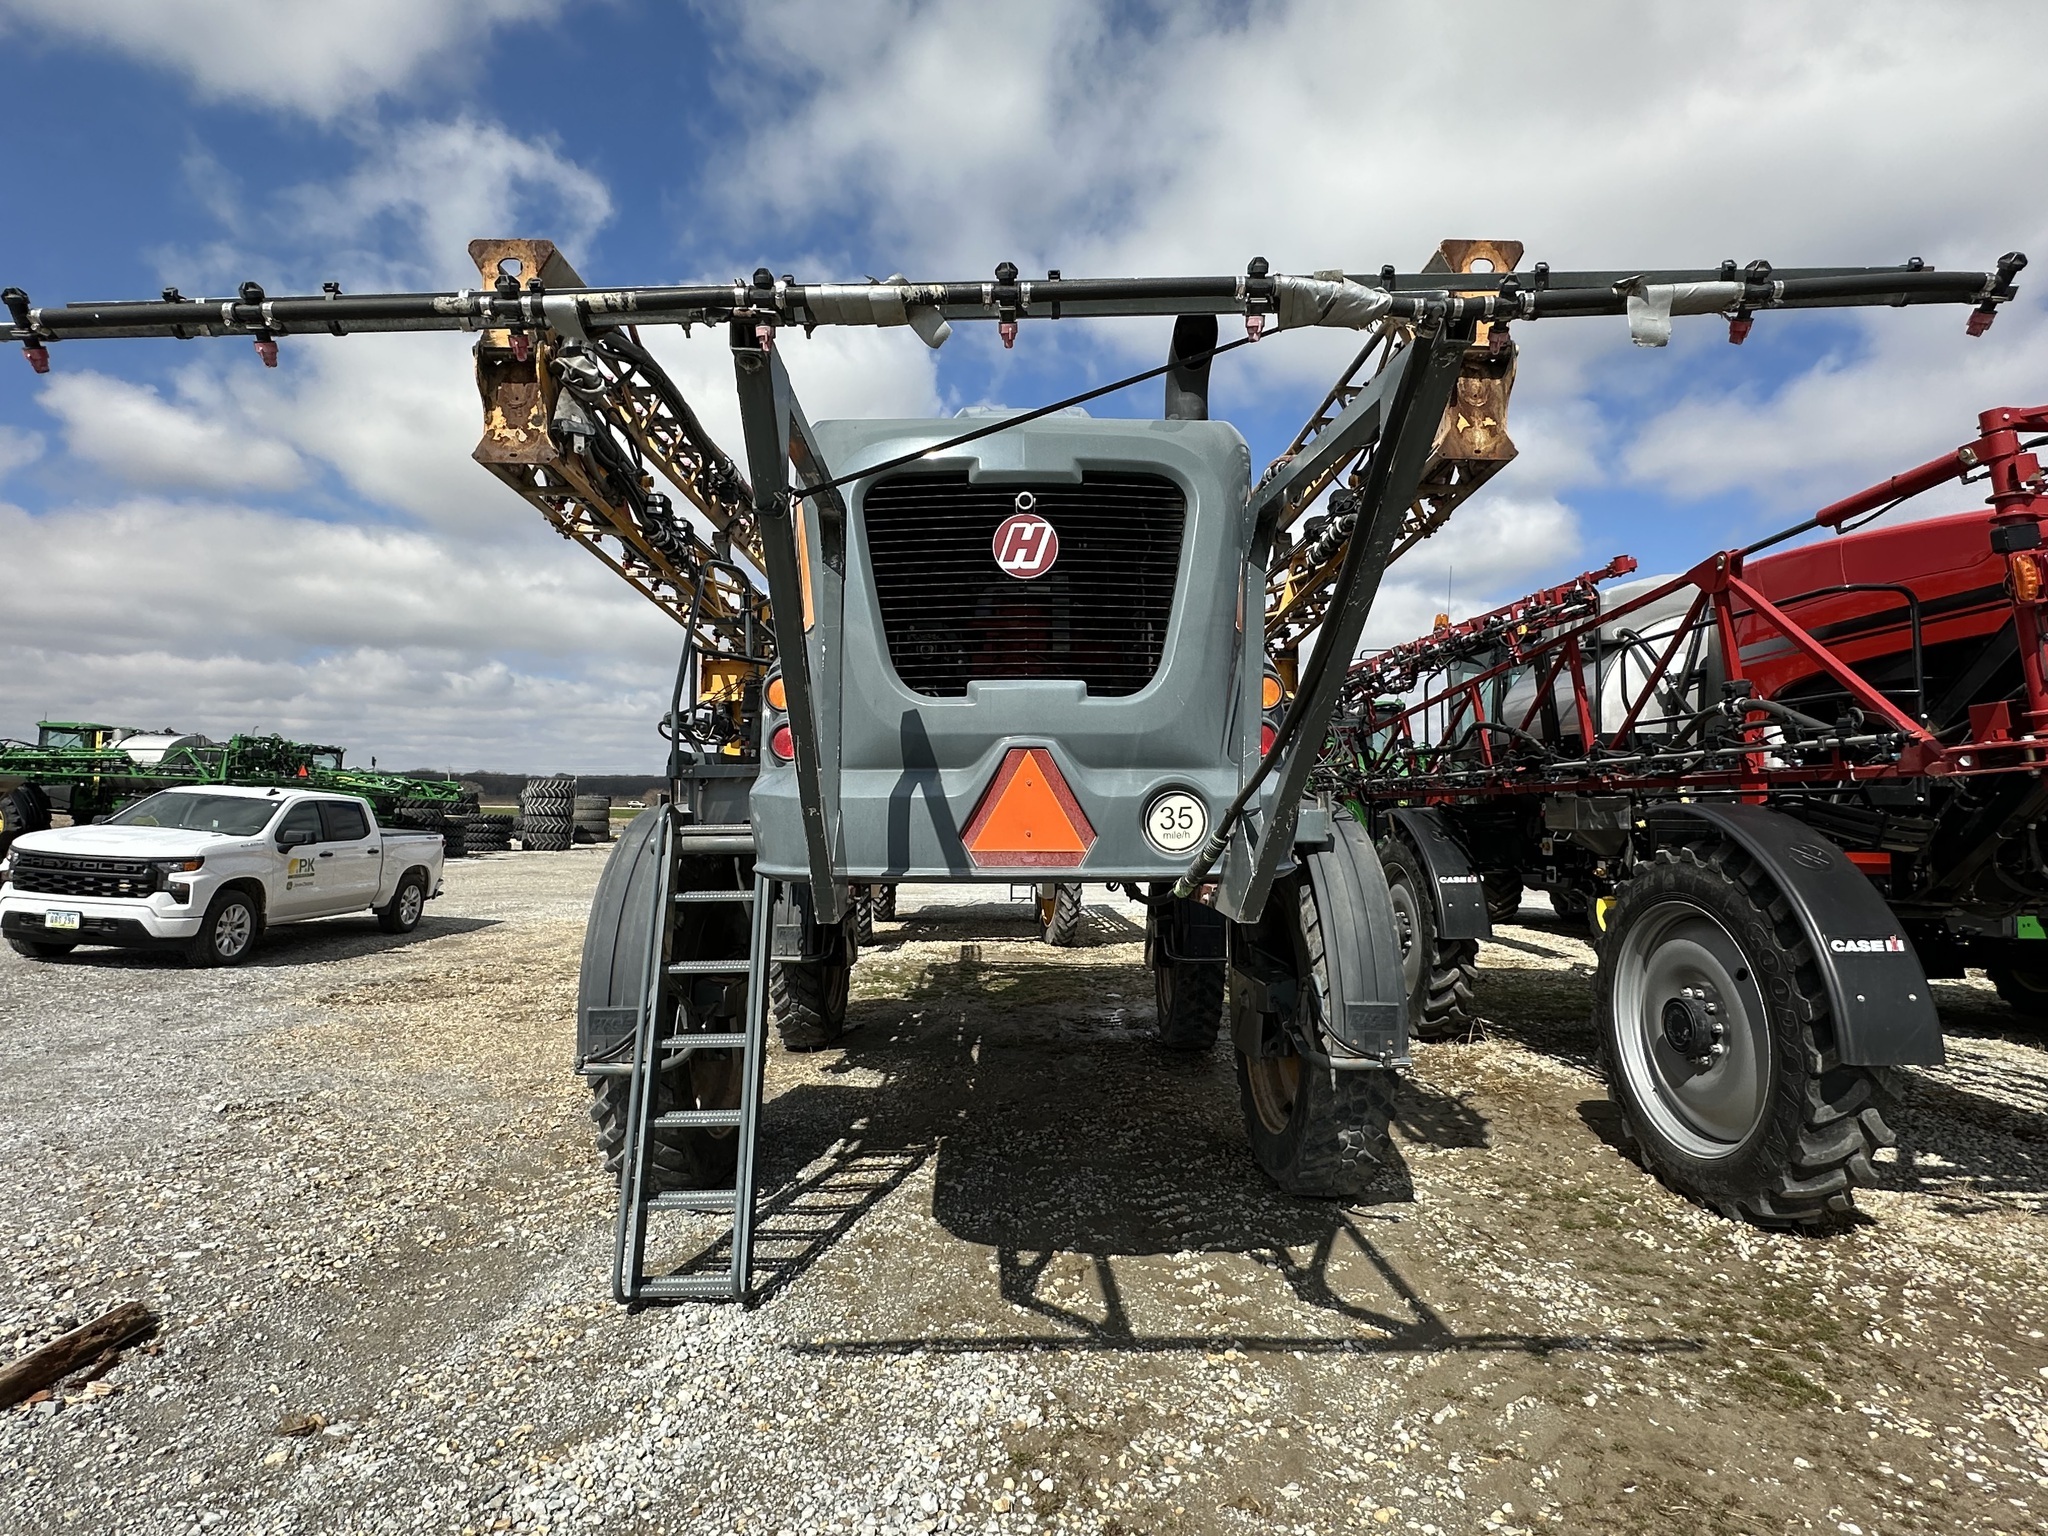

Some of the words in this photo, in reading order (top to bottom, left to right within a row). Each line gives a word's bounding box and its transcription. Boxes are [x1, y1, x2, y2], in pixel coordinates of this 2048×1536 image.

[998, 522, 1053, 570] H
[1160, 806, 1193, 830] 35
[1162, 830, 1190, 839] mile/h
[19, 857, 143, 873] CHEVROLET
[1439, 876, 1467, 884] CASE
[1830, 939, 1885, 952] CASE
[1746, 921, 1802, 1179] GOODYEAR
